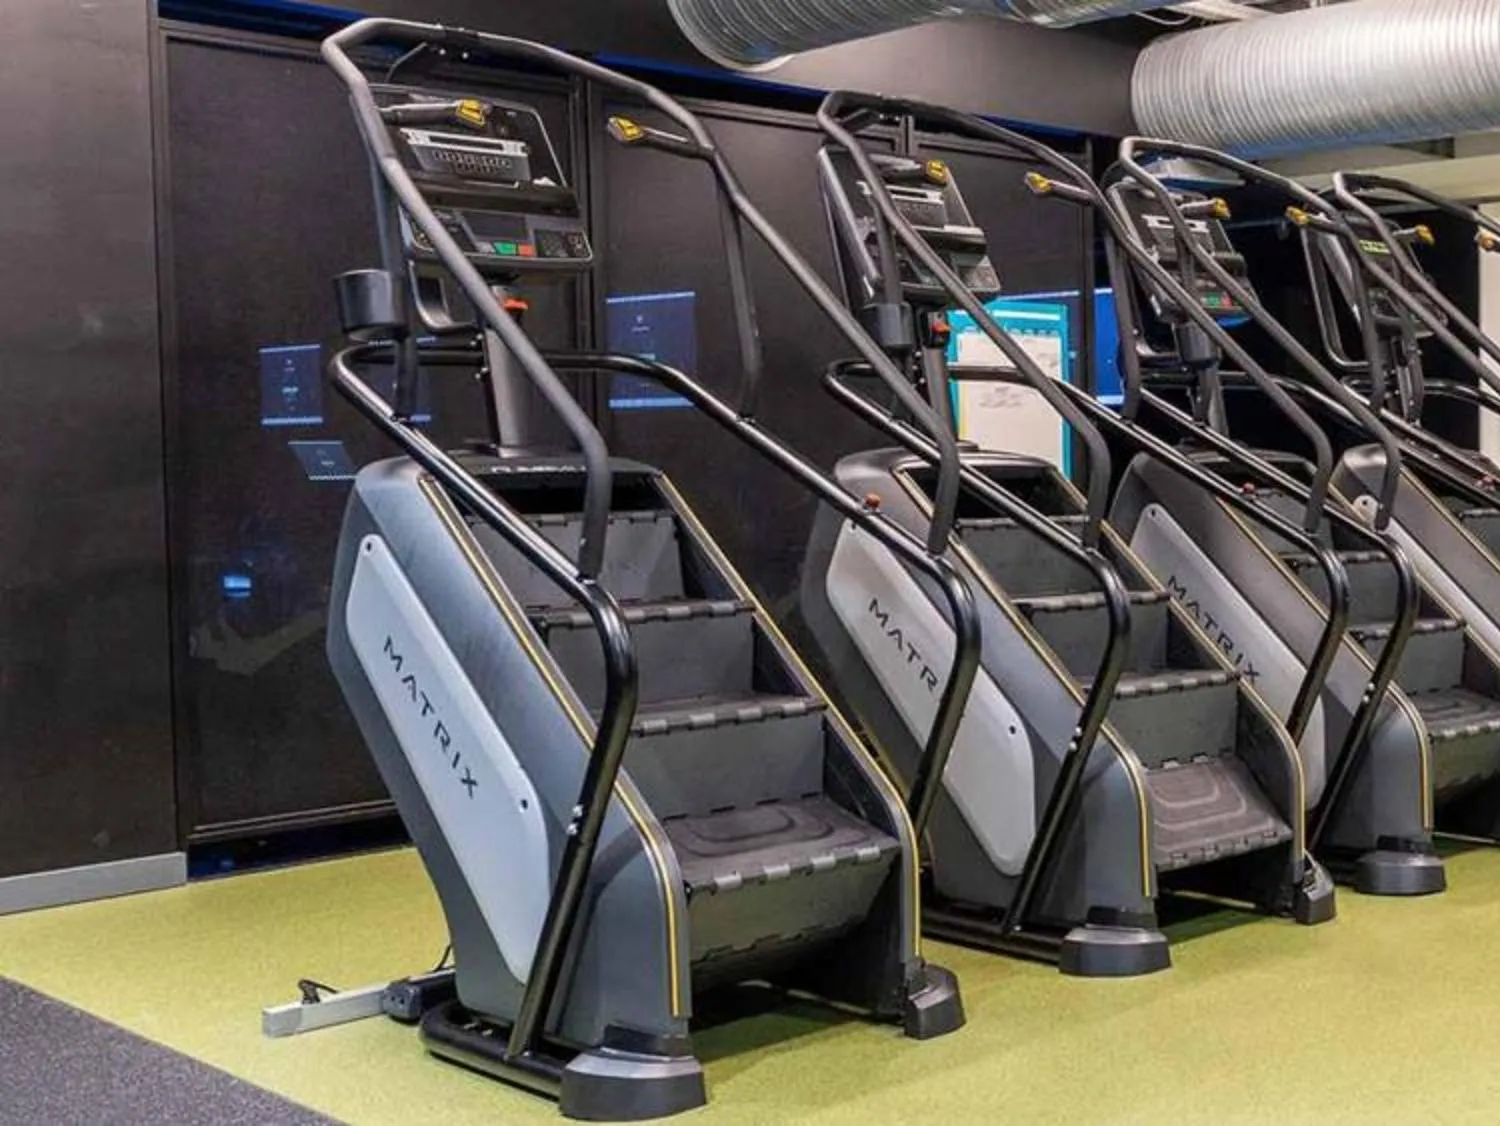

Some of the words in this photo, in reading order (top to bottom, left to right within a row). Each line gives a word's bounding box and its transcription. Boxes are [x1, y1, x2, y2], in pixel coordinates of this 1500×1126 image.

[869, 598, 939, 691] MATR
[1168, 575, 1260, 685] MATRIX
[384, 635, 479, 799] MATRIX
